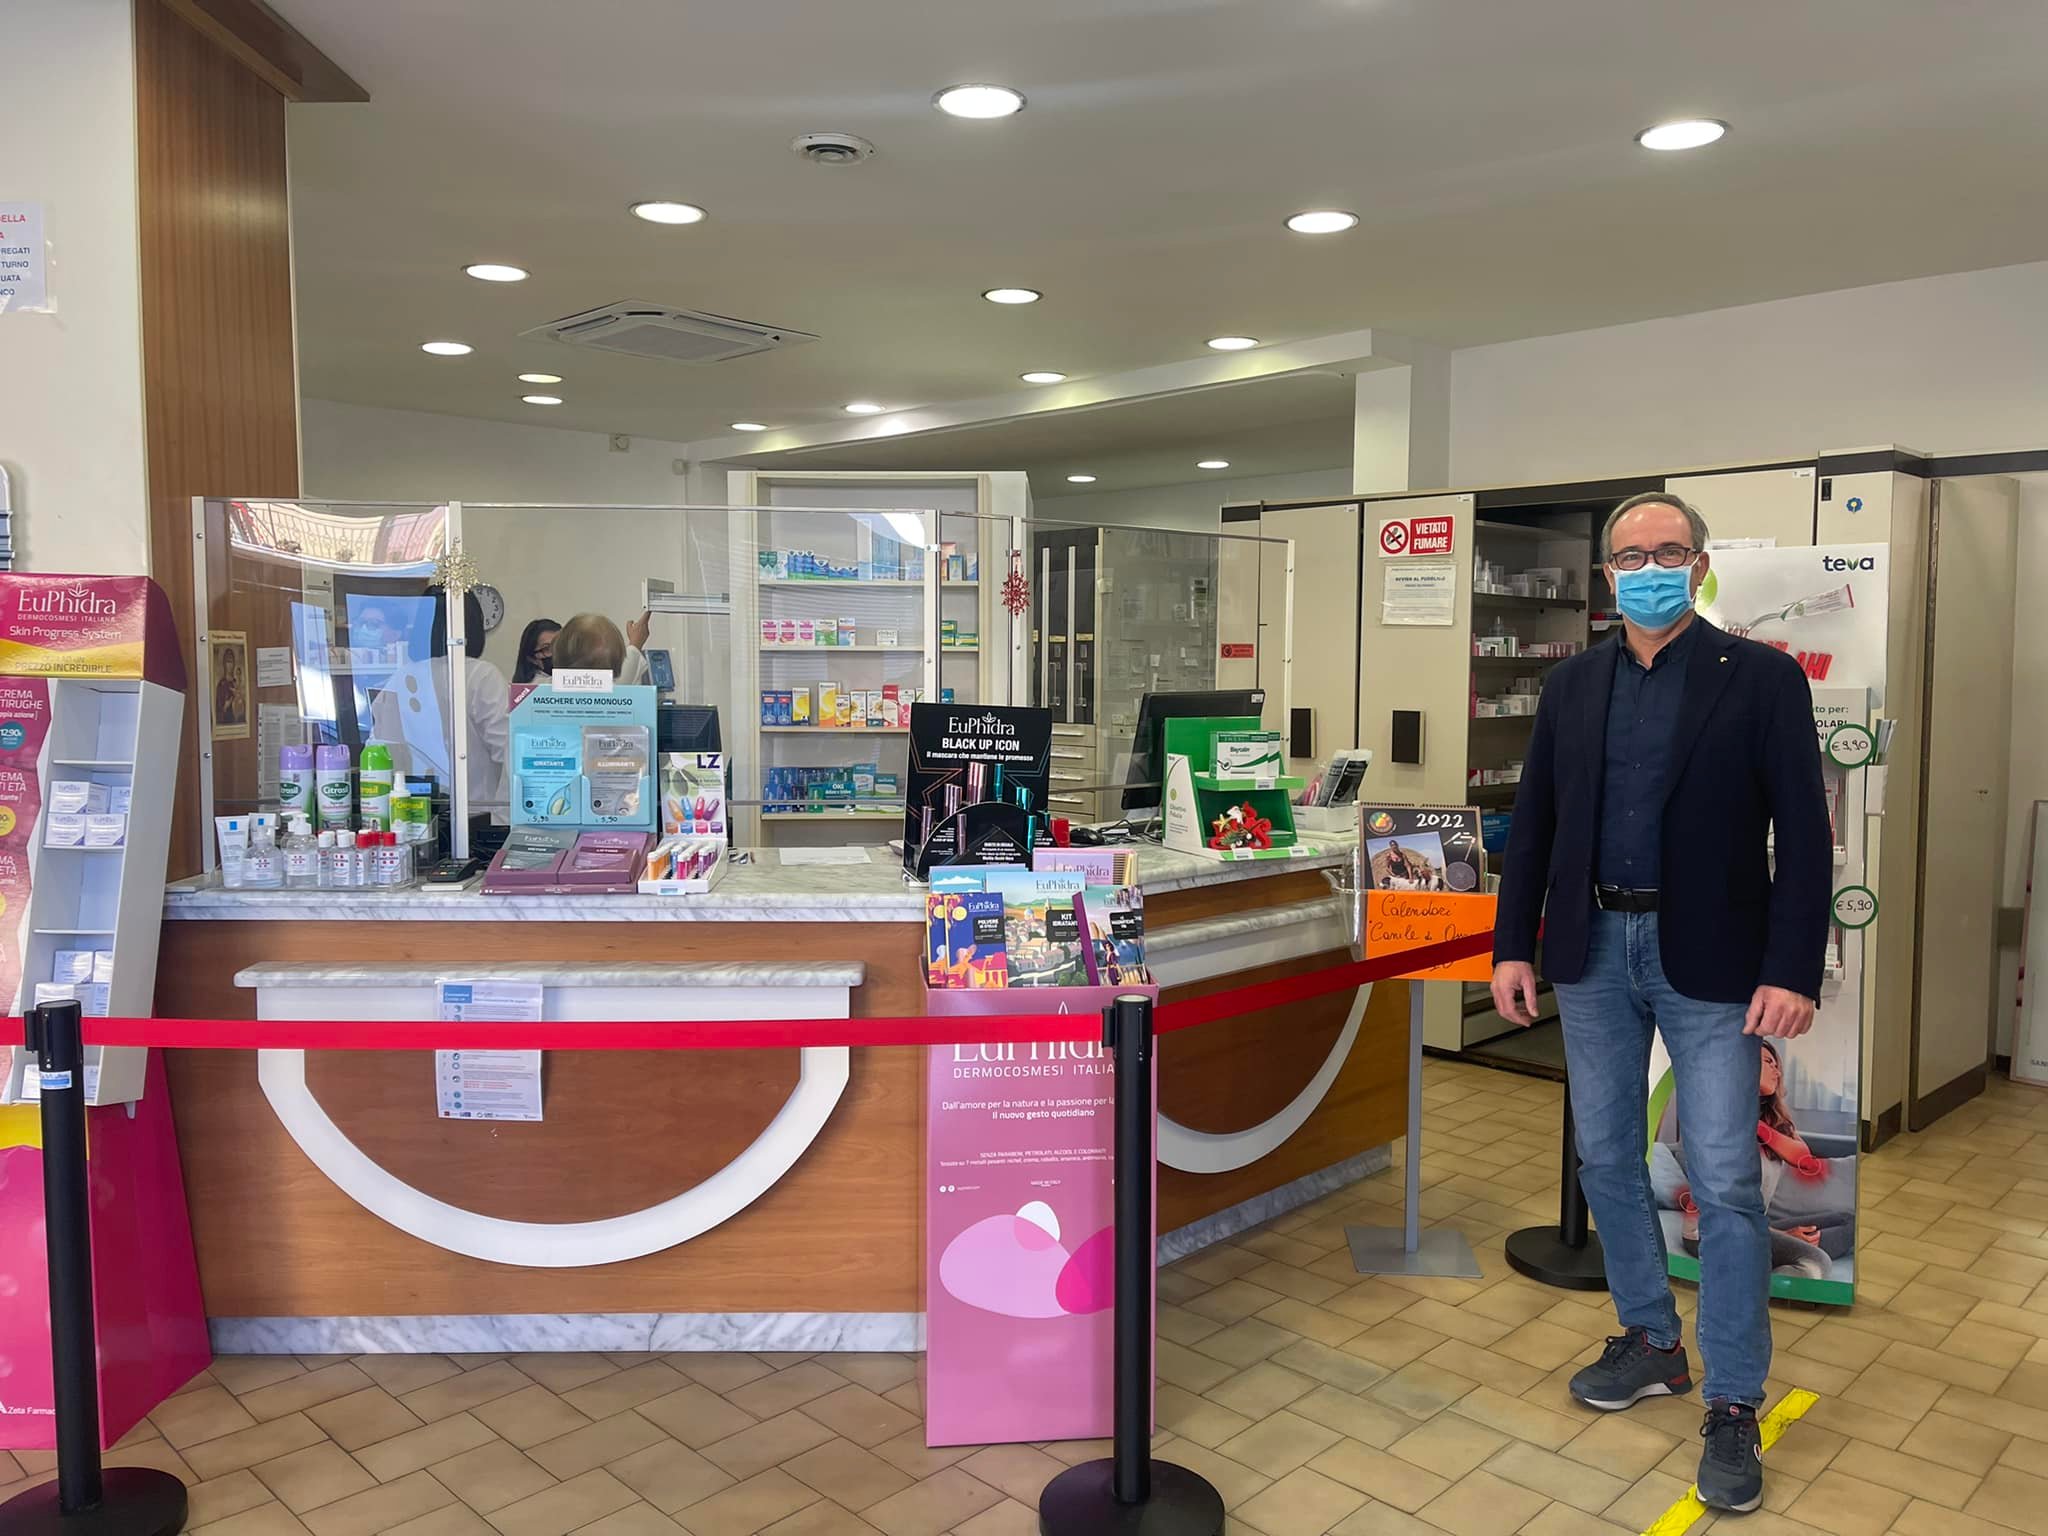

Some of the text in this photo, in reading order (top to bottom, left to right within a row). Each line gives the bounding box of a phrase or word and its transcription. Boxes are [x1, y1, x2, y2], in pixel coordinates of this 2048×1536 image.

[1415, 521, 1448, 535] VIETATO
[1413, 536, 1448, 550] FUMARE
[1822, 556, 1874, 571] teva
[18, 587, 116, 615] EuPhidra
[17, 614, 78, 622] DERMOCOSMESI
[9, 625, 122, 640] Skin Progress System
[53, 663, 113, 673] INCREDIBILE
[562, 675, 603, 687] EuPhidra
[533, 697, 574, 705] MASCHERE
[594, 698, 633, 706] MONOUSO
[1828, 707, 1849, 715] per:
[949, 716, 1015, 736] EuPhidra
[942, 738, 1020, 751] BLACK UP ICON
[697, 754, 720, 769] LZ
[932, 752, 957, 760] mascara
[971, 753, 998, 761] mantiene
[1005, 754, 1034, 762] promesse
[1416, 813, 1465, 829] 2022
[1036, 879, 1080, 890] EuPhidra
[1836, 900, 1873, 912] € 5,90
[953, 1065, 1065, 1079] DERMOCOSMESI
[942, 1101, 985, 1111] Dall'amore
[987, 1101, 1001, 1111] per
[1003, 1100, 1010, 1108] la
[1012, 1100, 1039, 1108] natura
[1047, 1098, 1055, 1107] la
[1056, 1098, 1092, 1108] passione
[1093, 1098, 1107, 1107] per
[992, 1109, 1095, 1120] Il nuovo gesto quotidiano
[7, 1406, 26, 1415] Zeta
